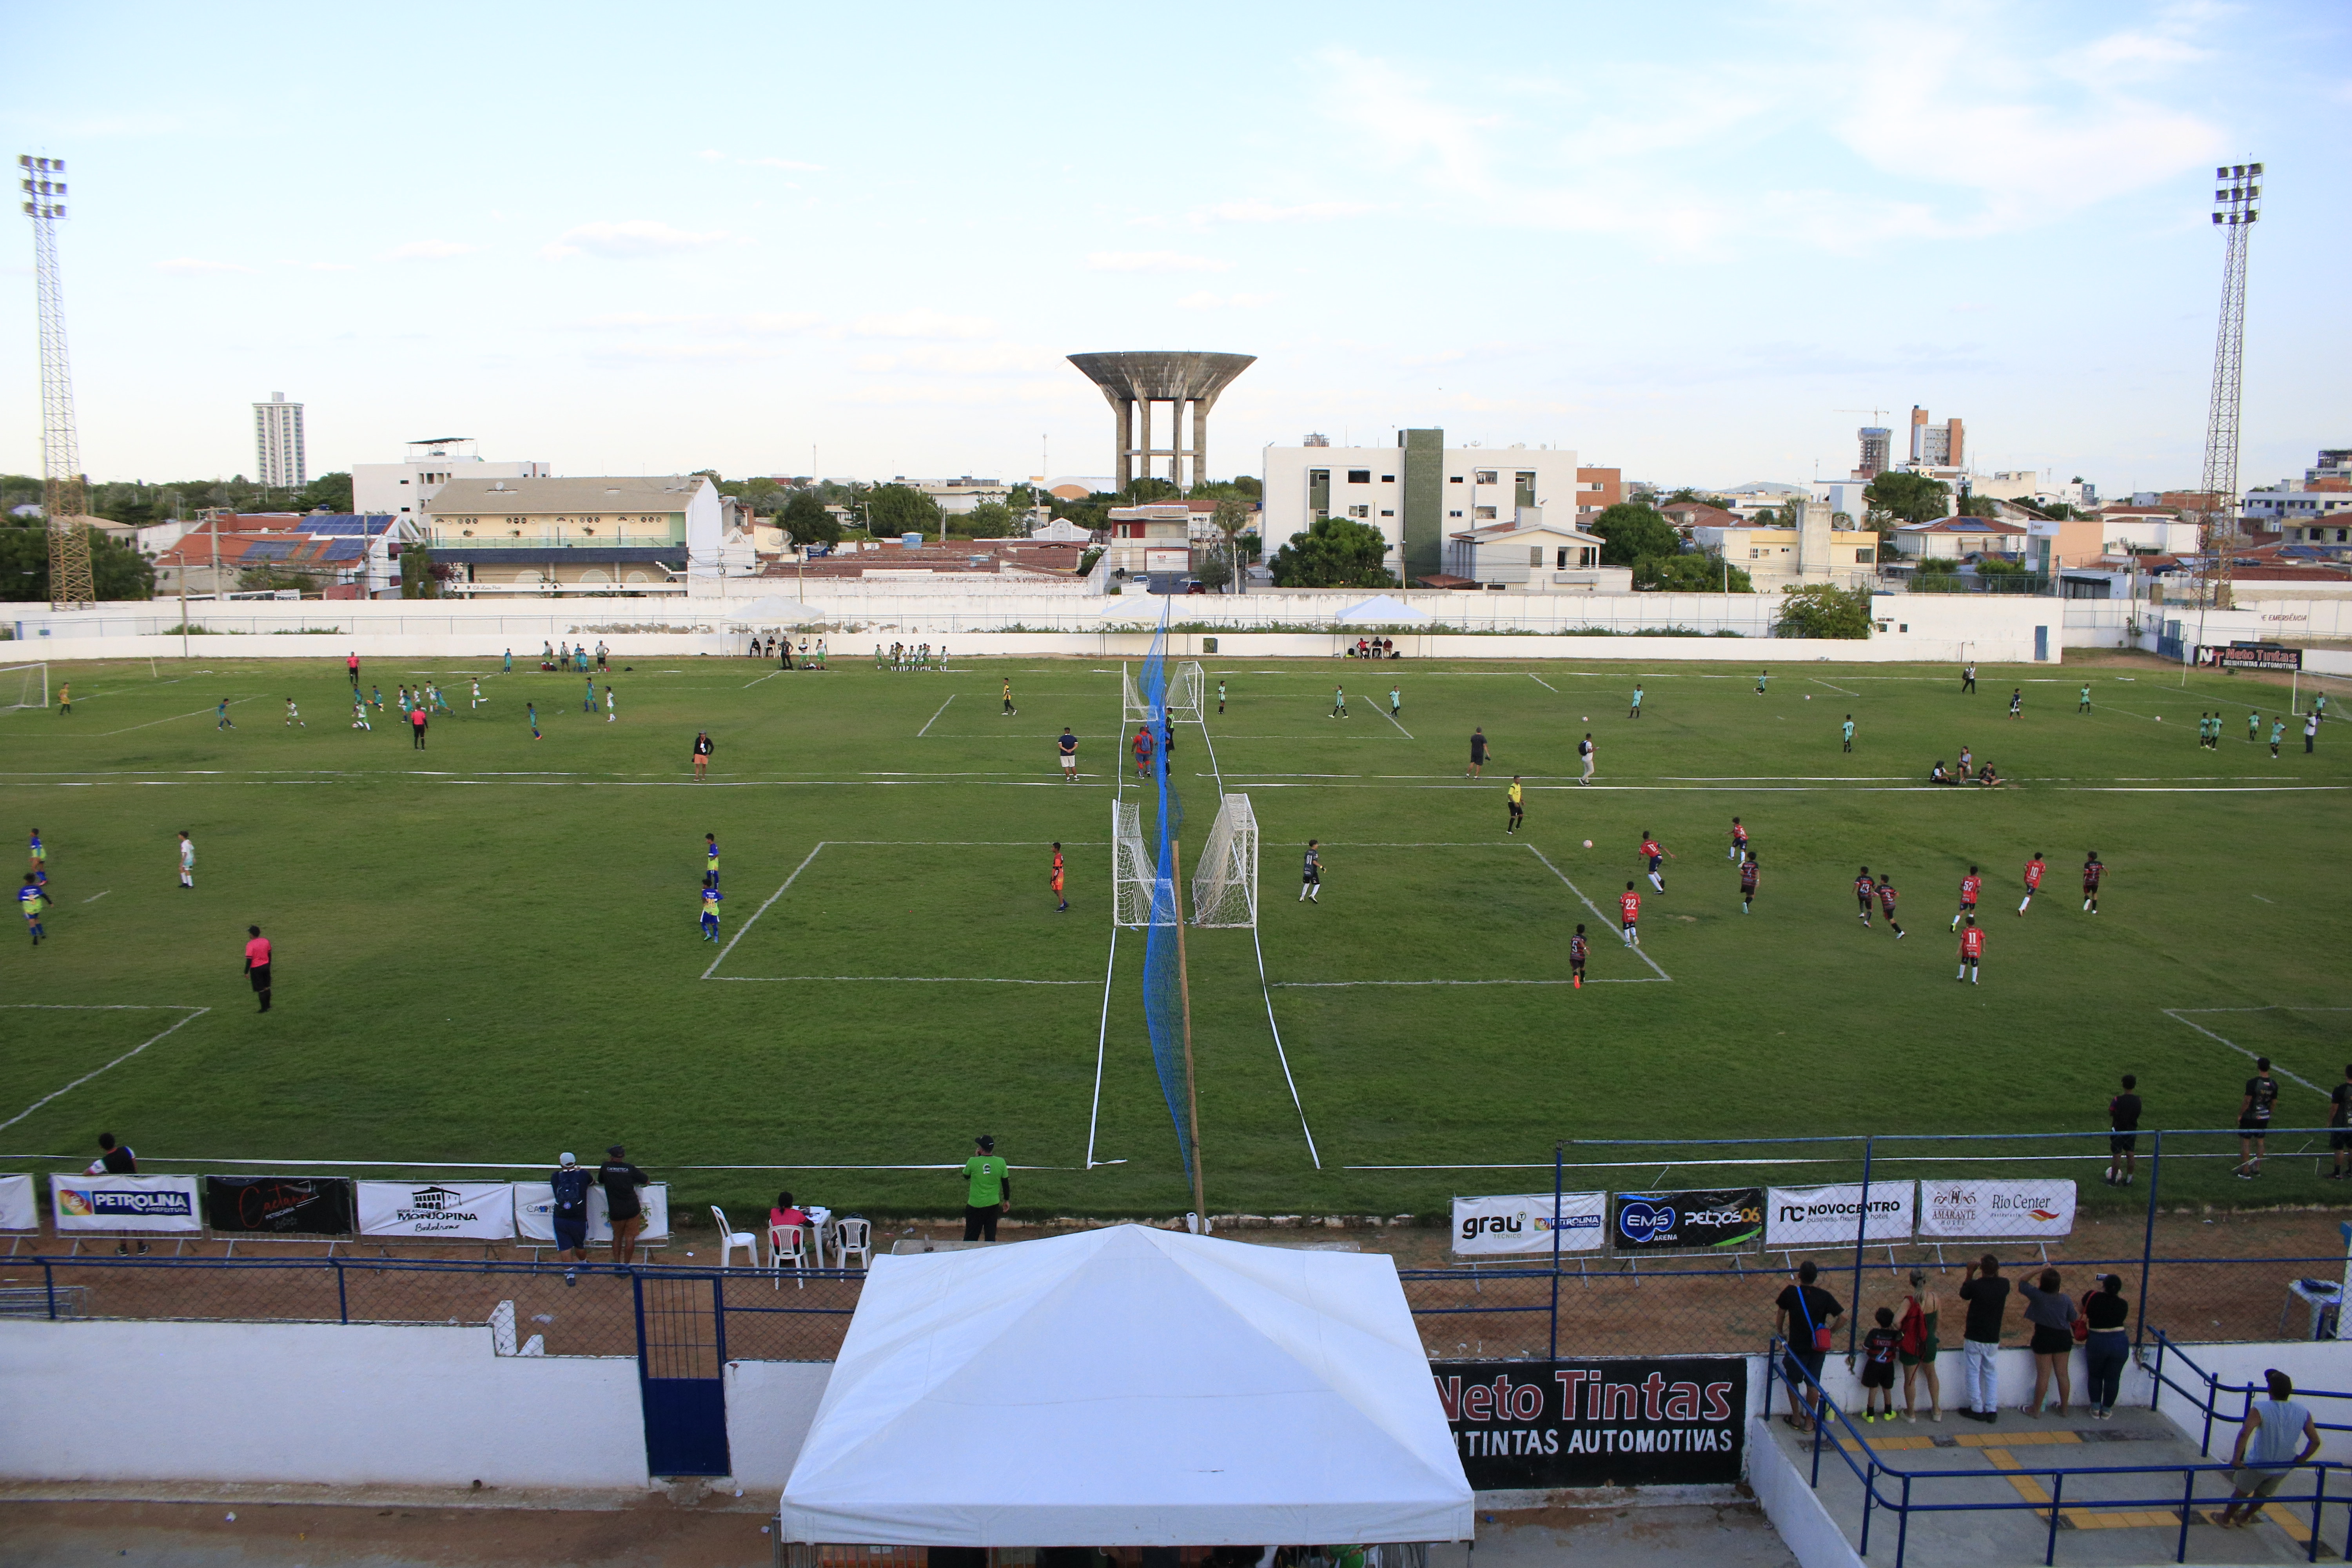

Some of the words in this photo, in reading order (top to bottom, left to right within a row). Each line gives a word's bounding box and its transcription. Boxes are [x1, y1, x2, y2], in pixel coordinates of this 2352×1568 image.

[2225, 648, 2254, 660] Neto
[2257, 650, 2297, 662] Tintas
[2259, 661, 2298, 670] AUTOMOTIVAS
[1306, 855, 1313, 865] 61
[2030, 866, 2039, 877] 10
[1964, 880, 1973, 891] 52
[1626, 898, 1636, 909] 22
[1968, 932, 1976, 944] 11
[95, 1194, 187, 1211] PETROLINA
[1992, 1194, 2011, 1208] Rio
[2013, 1194, 2051, 1208] Center
[397, 1212, 478, 1221] MONJOPINA
[1933, 1209, 1975, 1219] AMARANTE
[1627, 1214, 1669, 1227] EMS
[1462, 1216, 1521, 1239] grau
[1555, 1370, 1732, 1421] Tintas
[1466, 1429, 1559, 1456] TINTAS
[1568, 1429, 1733, 1453] AUTOMOTIVAS
